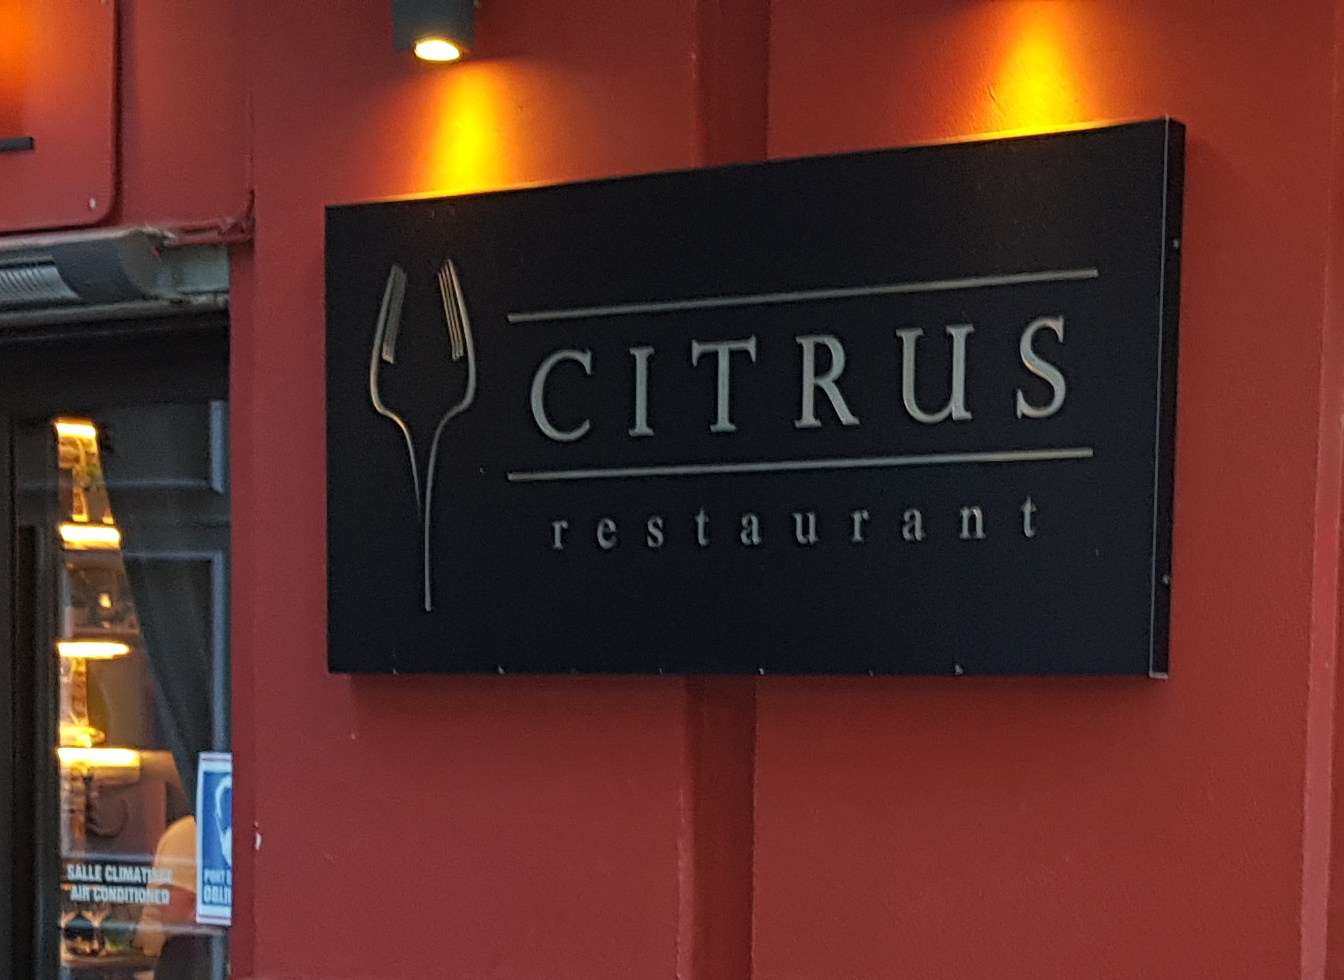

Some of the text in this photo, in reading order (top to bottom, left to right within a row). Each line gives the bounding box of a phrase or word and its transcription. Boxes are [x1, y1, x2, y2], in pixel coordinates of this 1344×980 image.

[529, 314, 1070, 444] CITRUS
[550, 496, 1040, 550] restaurant
[66, 863, 103, 882] SALLE
[70, 884, 170, 905] AIR CONDITIONED
